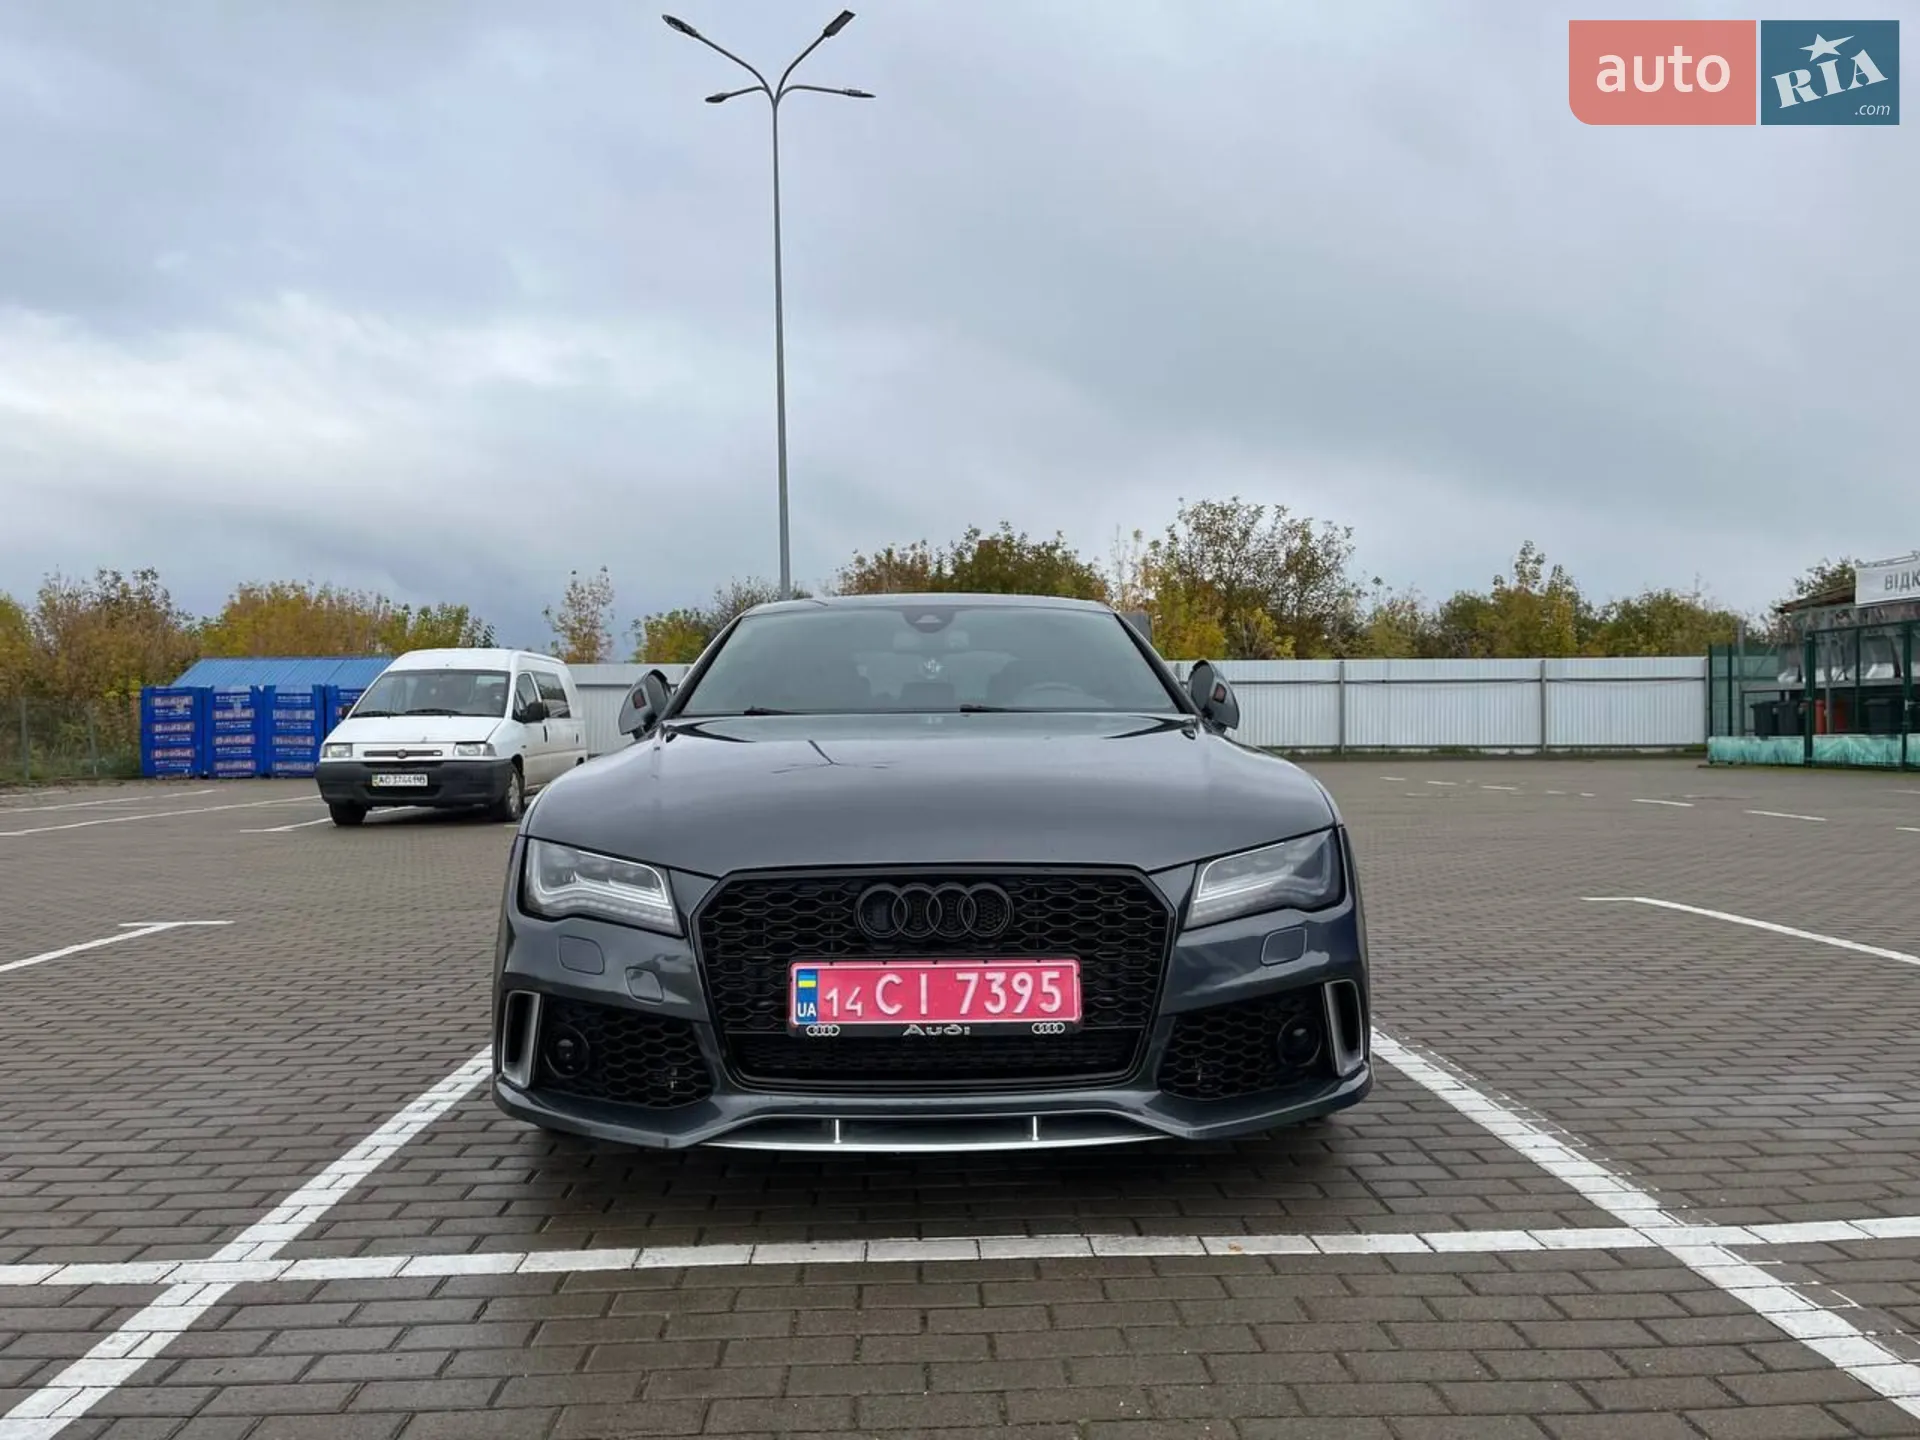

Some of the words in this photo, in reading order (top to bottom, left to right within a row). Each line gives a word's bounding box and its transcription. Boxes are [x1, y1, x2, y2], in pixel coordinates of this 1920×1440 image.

[825, 986, 864, 1018] 14
[955, 970, 1062, 1016] 7395
[797, 1001, 817, 1018] UA
[902, 1024, 970, 1036] Audi
